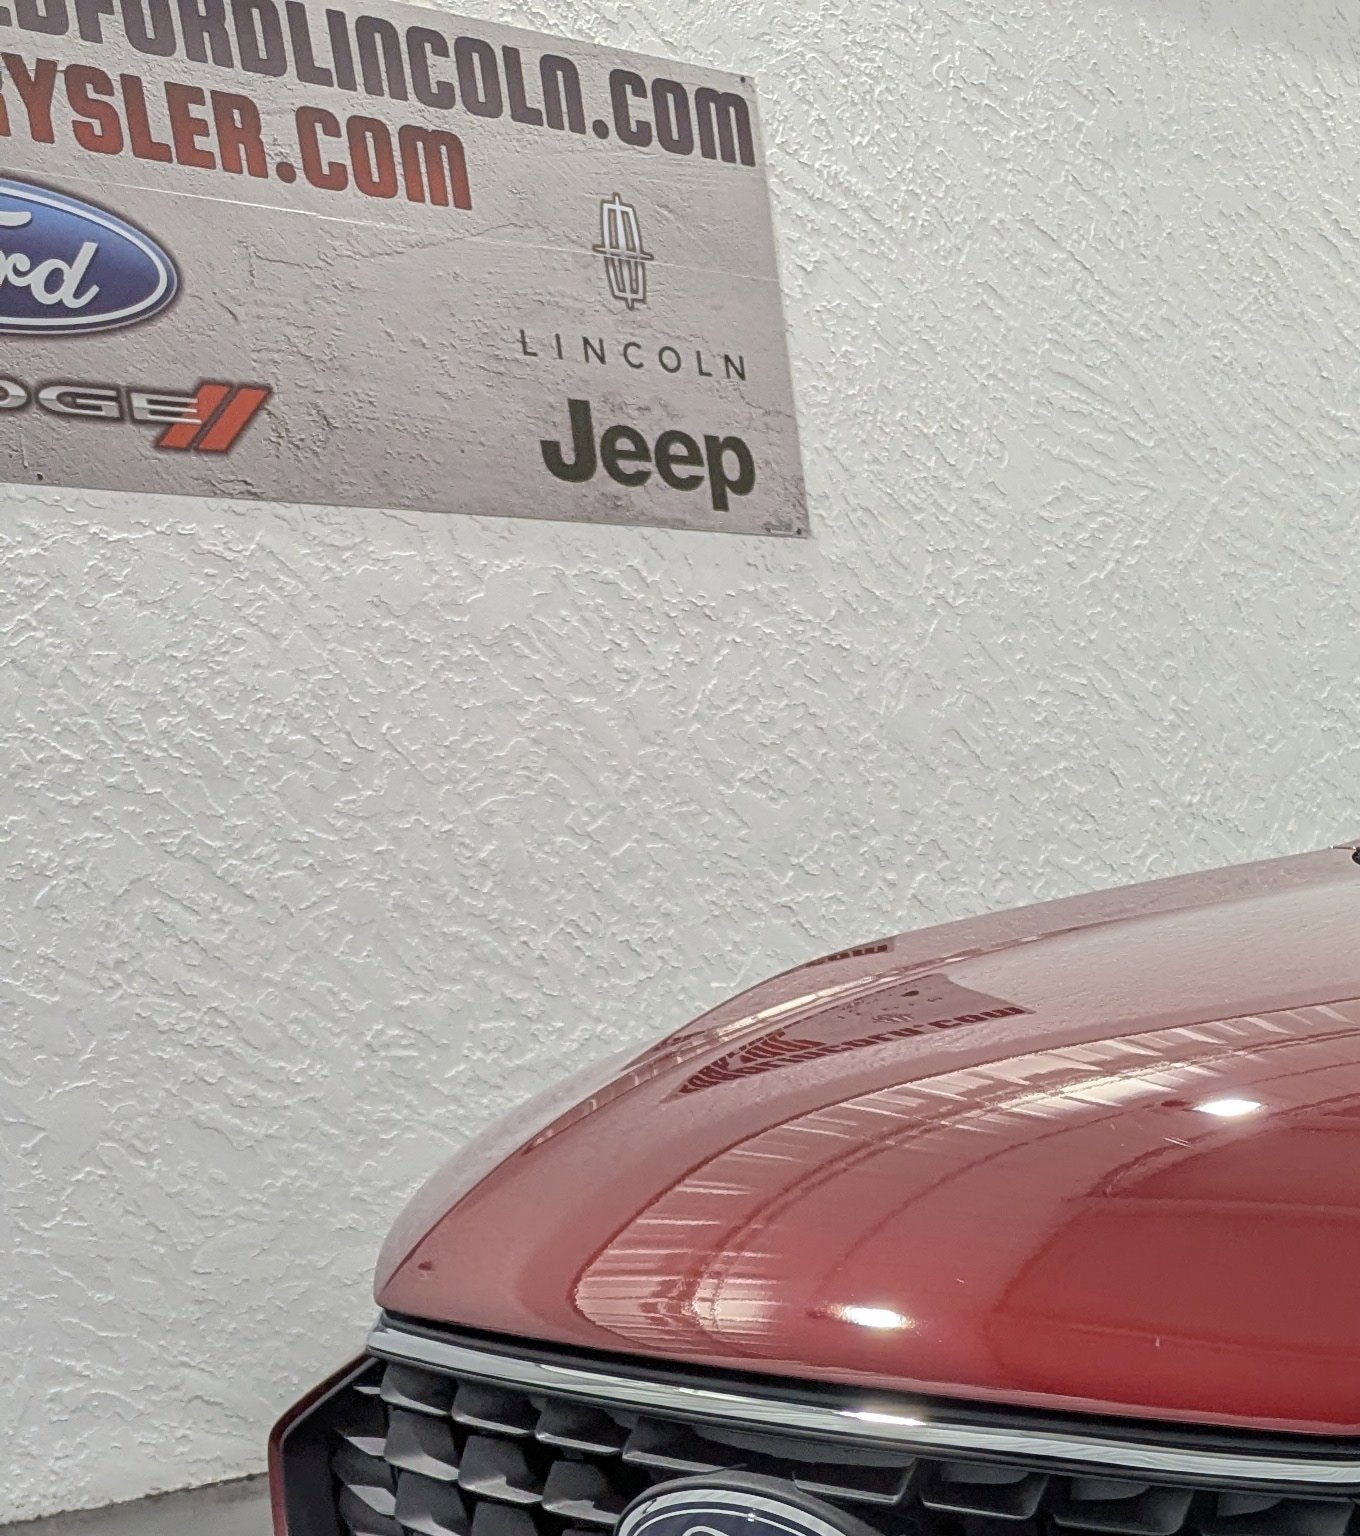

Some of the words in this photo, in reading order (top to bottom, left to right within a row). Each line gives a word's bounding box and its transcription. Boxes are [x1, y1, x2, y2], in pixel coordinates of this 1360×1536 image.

[0, 0, 756, 168] FORDLINCOLN.COM
[0, 52, 473, 211] YSLER.COM
[0, 211, 100, 309] rd
[520, 329, 746, 381] LINCOLN
[540, 399, 756, 512] Jeep
